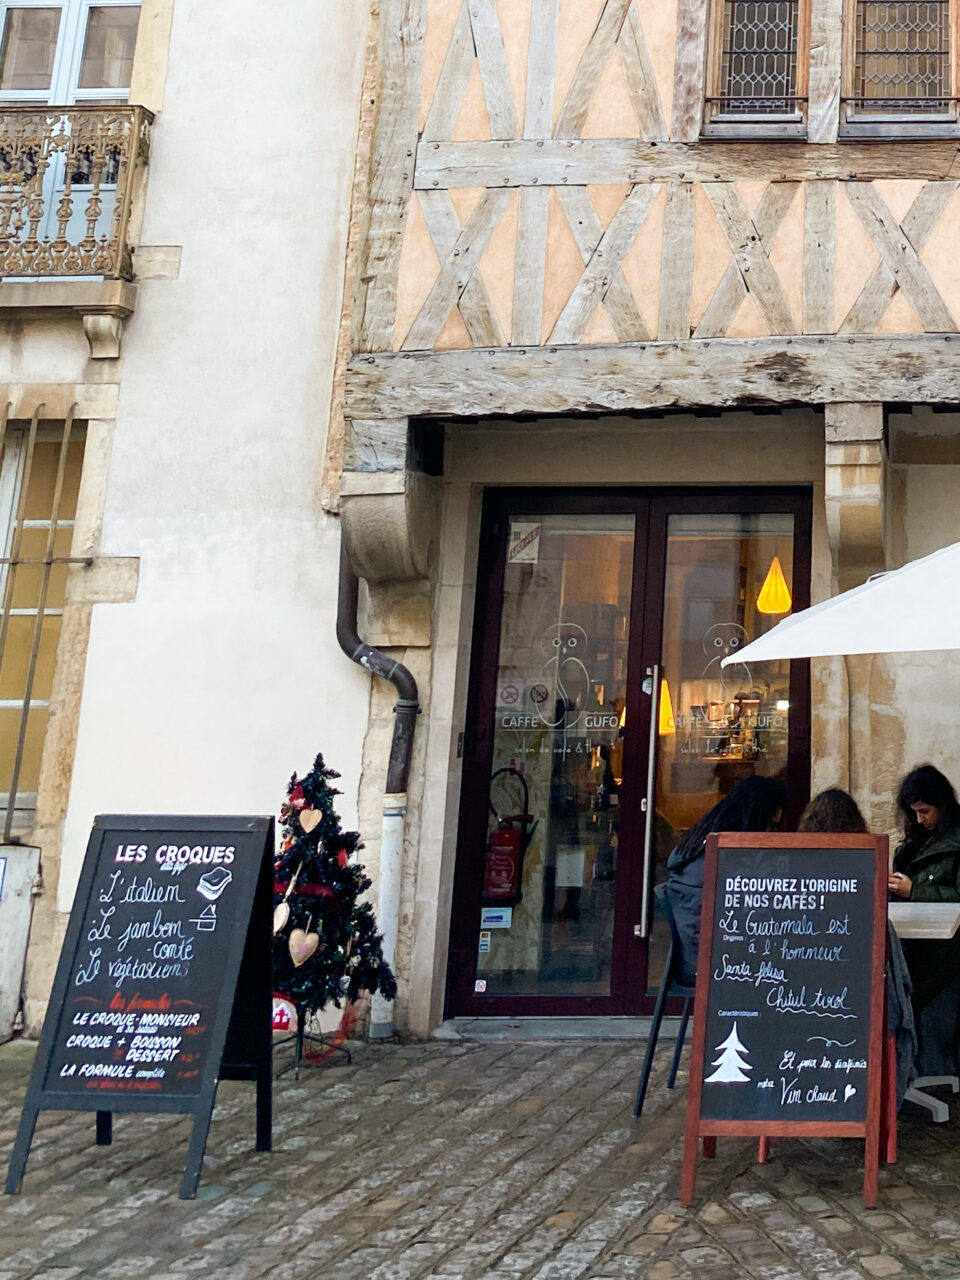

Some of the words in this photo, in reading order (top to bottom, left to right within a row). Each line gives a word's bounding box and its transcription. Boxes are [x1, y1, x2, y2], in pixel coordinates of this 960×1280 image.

[584, 715, 619, 728] GUFO
[115, 845, 148, 862] LES
[155, 845, 236, 864] CROQUES
[725, 876, 797, 892] DÉCOUVREZ
[800, 879, 858, 893] L'ORIGINE
[724, 894, 741, 908] DE
[744, 894, 770, 908] NOS
[773, 892, 817, 910] CAFÉS
[87, 906, 116, 941] Le
[719, 910, 740, 933] Le
[745, 910, 821, 936] Guatemala
[825, 914, 853, 936] est
[75, 947, 102, 986] Le
[714, 954, 752, 981] Santa
[73, 1013, 90, 1025] LE
[90, 1013, 201, 1027] CROQUE-MONSIEUR
[66, 1035, 113, 1049] CROQUE
[130, 1035, 182, 1049] BOISSON
[125, 1049, 180, 1063] DESSERT
[778, 1050, 797, 1070] Et
[60, 1064, 76, 1077] LA
[78, 1064, 135, 1078] FORMULE
[806, 1085, 838, 1103] chaud
